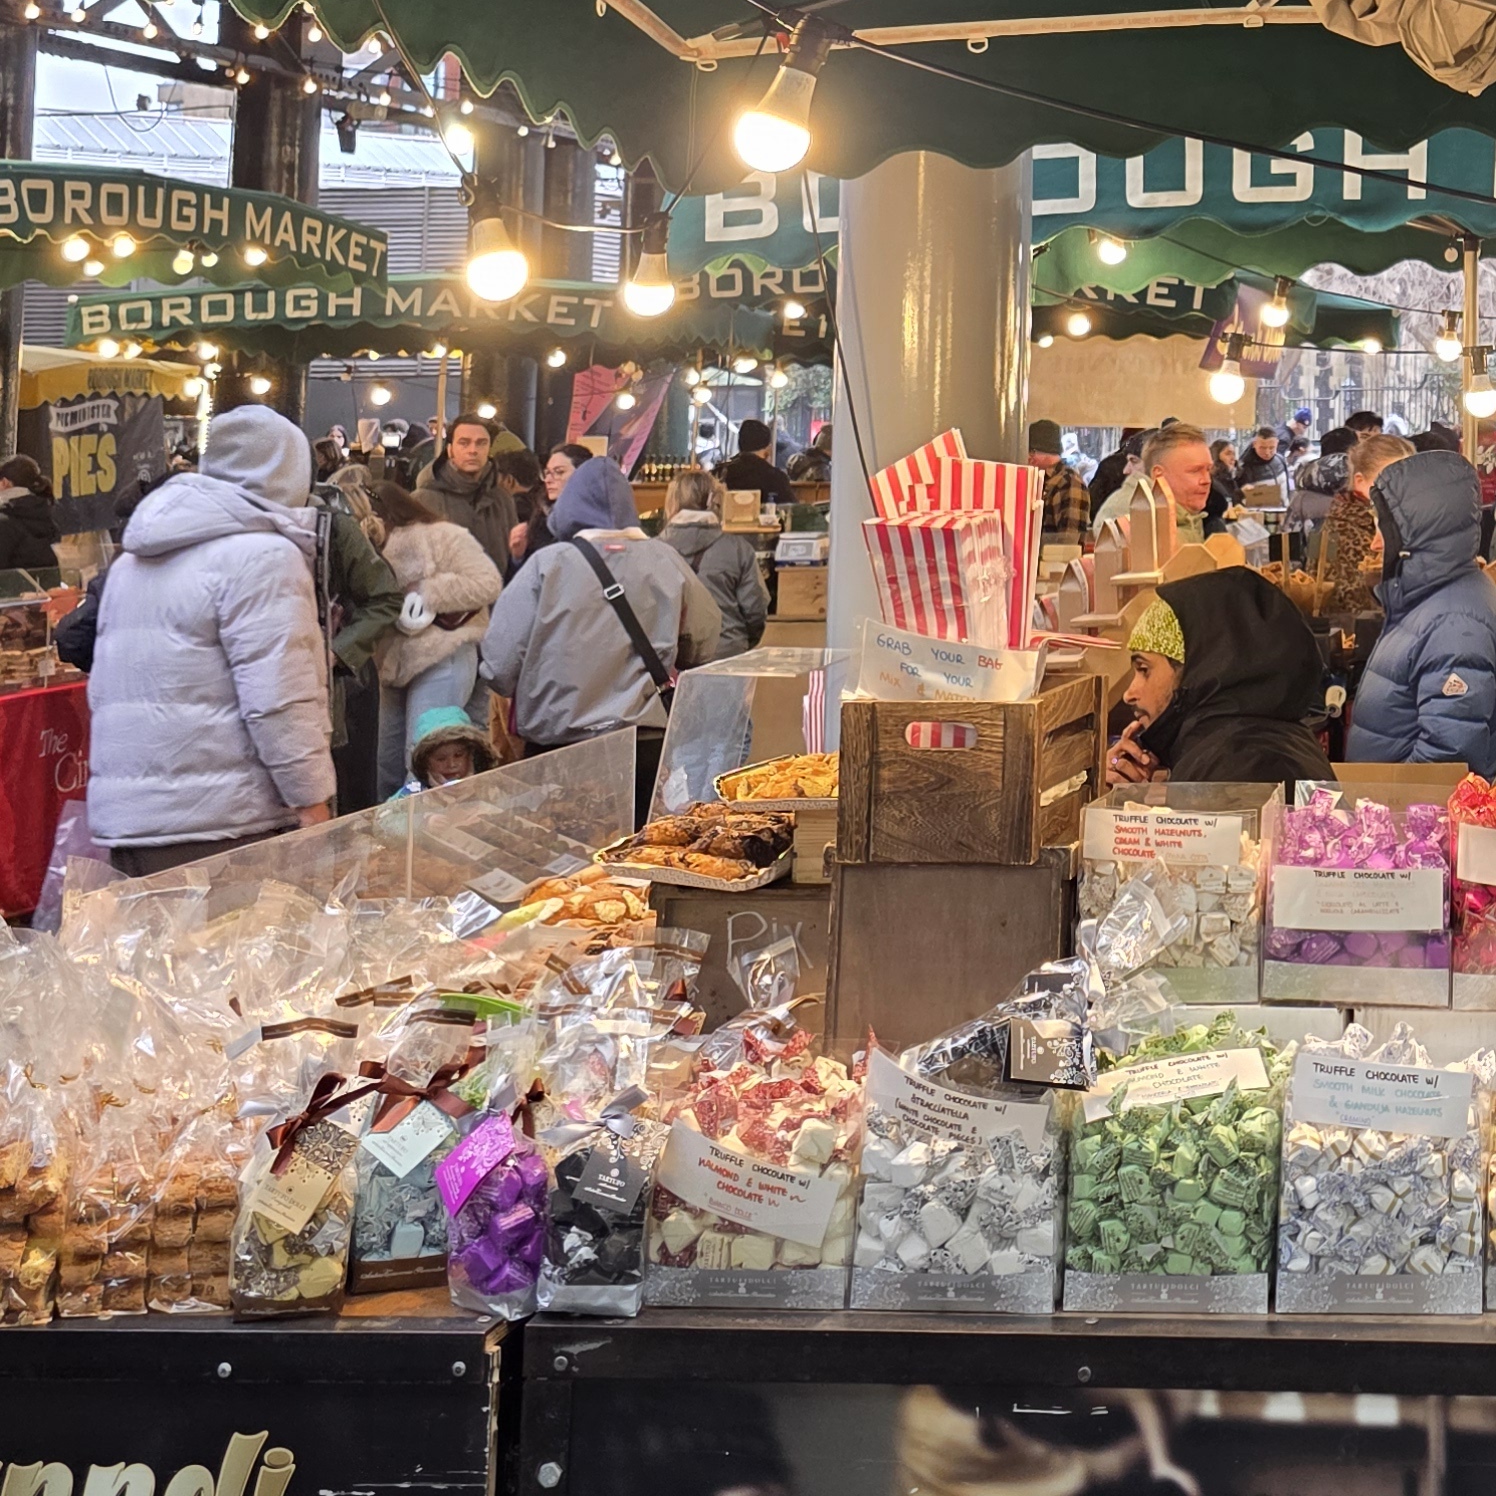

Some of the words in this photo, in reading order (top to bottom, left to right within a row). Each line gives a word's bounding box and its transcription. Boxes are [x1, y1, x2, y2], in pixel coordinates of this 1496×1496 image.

[245, 202, 387, 276] MARKET
[81, 287, 362, 336] BOROUGH
[52, 433, 116, 499] PIES
[877, 634, 912, 654] GRAB
[931, 648, 965, 664] YOUR
[978, 655, 1003, 670] BAG
[900, 662, 921, 677] FOR
[944, 673, 973, 688] YOUR
[39, 728, 68, 758] The
[1113, 814, 1148, 823] TRUFFLE
[1156, 816, 1199, 825] CHOCOLATE
[1114, 825, 1148, 834] SMOOTH
[1112, 847, 1156, 858] CHOCOLATE
[1314, 870, 1345, 879] TRUFFLE
[1125, 1064, 1158, 1076] TRUFFLE
[1168, 1055, 1211, 1067] CHOCOLATE
[1313, 1062, 1355, 1077] TRUFFLE
[1366, 1070, 1419, 1084] CHOCOLATE
[1152, 1074, 1204, 1089] CHOCOLATE
[1313, 1078, 1353, 1092] SMOOTH
[1362, 1085, 1385, 1097] MILK
[904, 1076, 936, 1096] TRUFFLE
[944, 1093, 988, 1110] CHOCOLATE
[902, 1114, 940, 1135] CHOCOLATE
[923, 1113, 962, 1132] CHOCOLATE
[709, 1145, 744, 1168] TRUFFLE
[752, 1163, 796, 1183] CHOCOLATE
[717, 1180, 764, 1204] CHOCOLATE
[758, 1183, 788, 1196] WHITE
